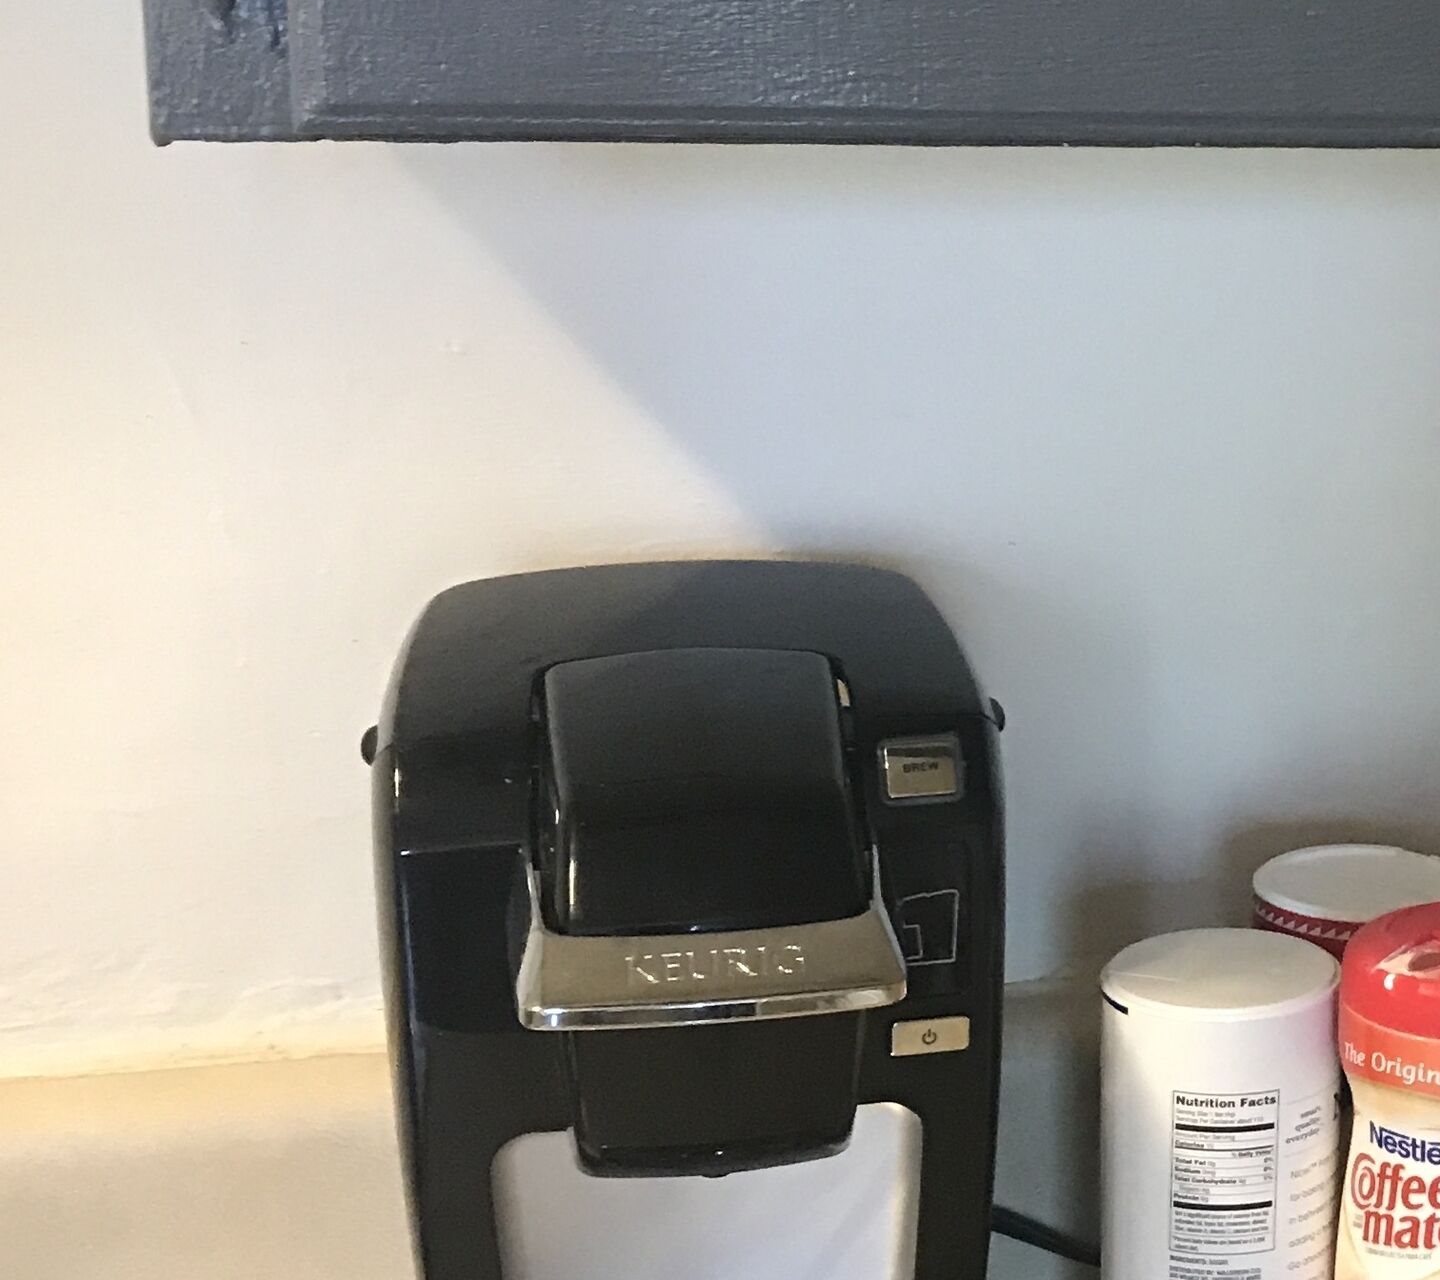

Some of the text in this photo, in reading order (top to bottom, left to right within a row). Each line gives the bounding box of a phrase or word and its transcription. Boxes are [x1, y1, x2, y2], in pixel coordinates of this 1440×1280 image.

[902, 761, 939, 774] BREW
[624, 944, 806, 985] KEURIG
[1343, 1041, 1367, 1067] The
[1176, 1095, 1277, 1109] Nutrition Facts
